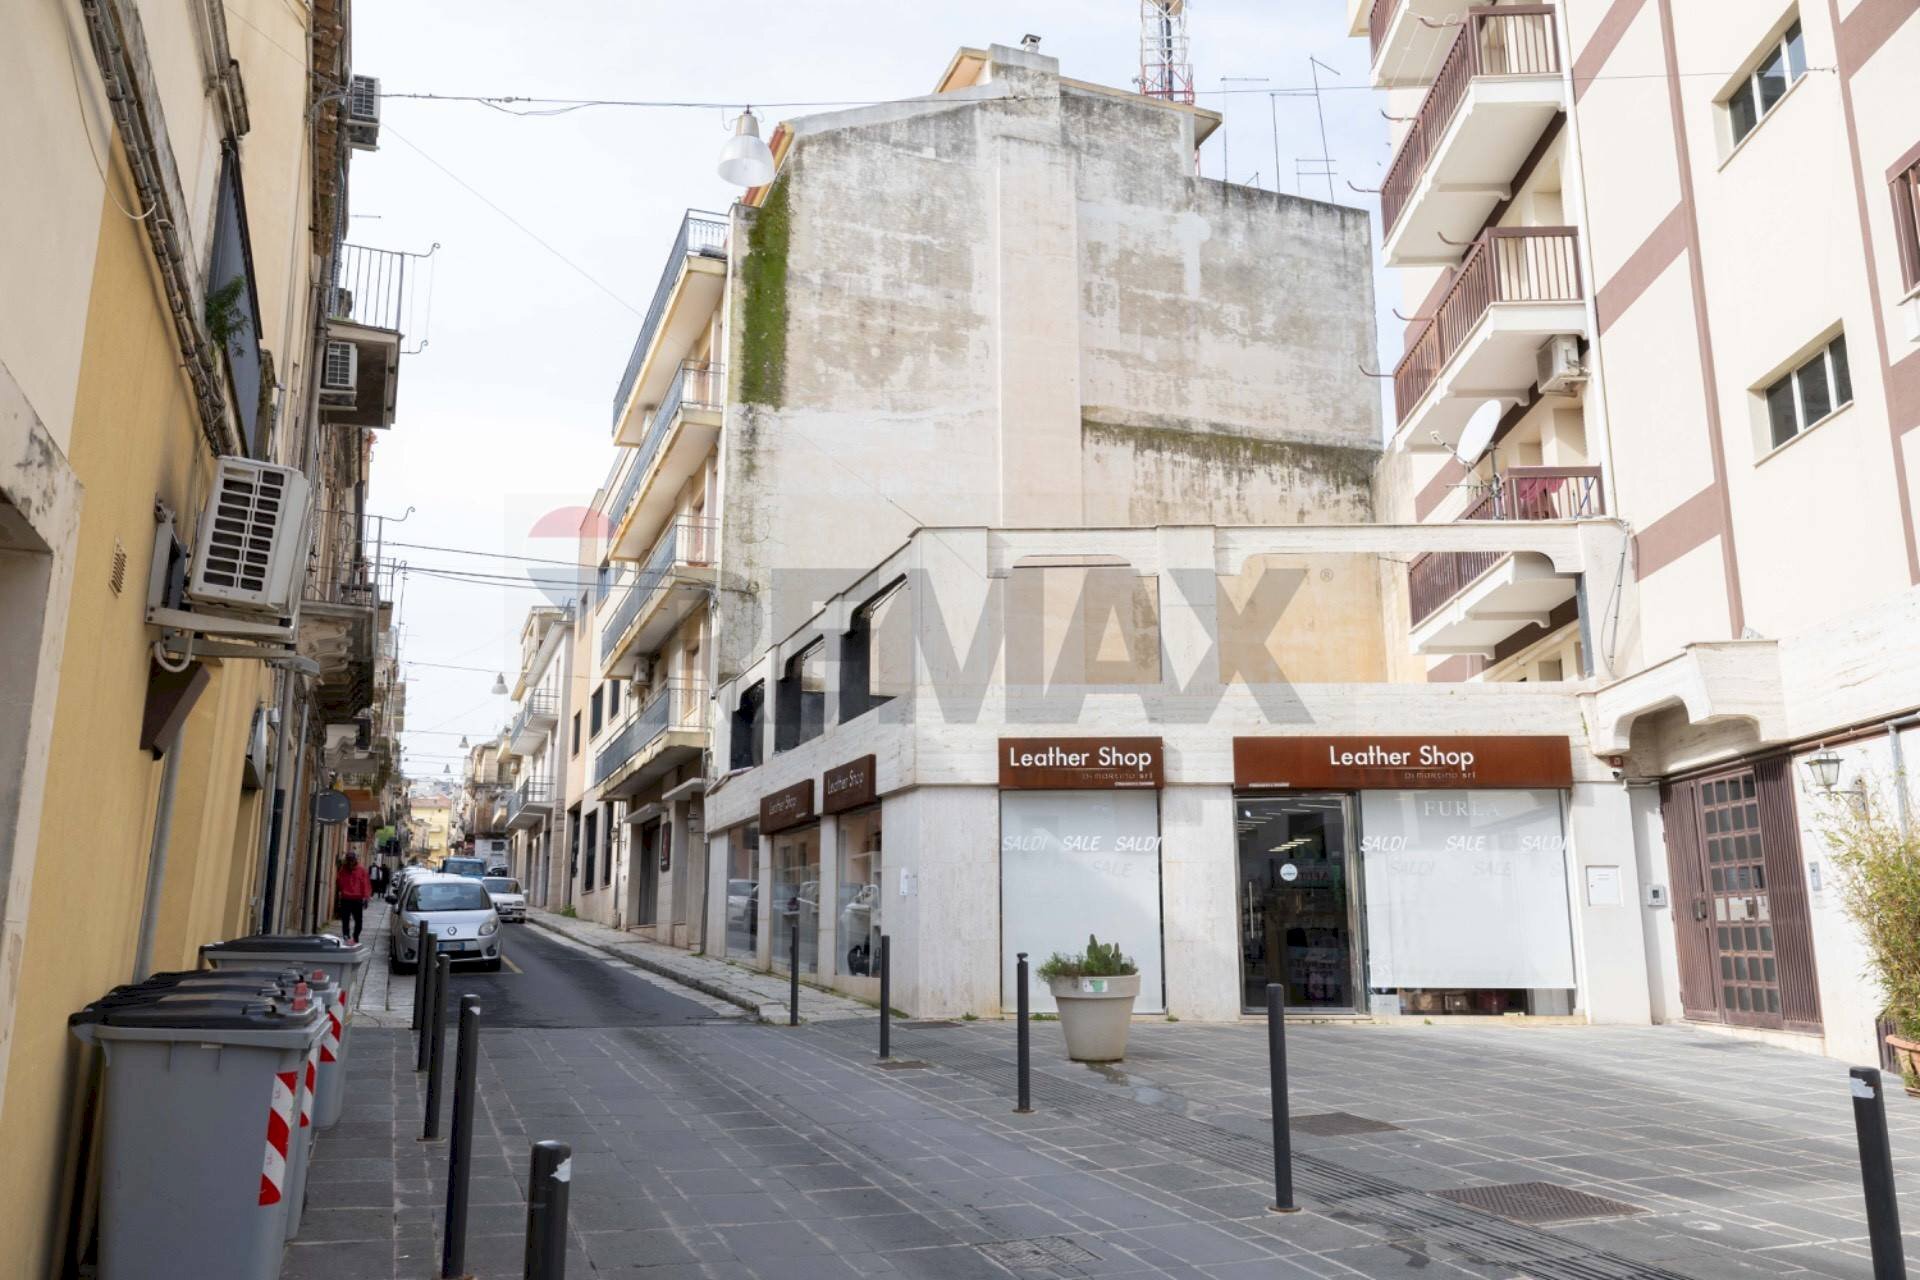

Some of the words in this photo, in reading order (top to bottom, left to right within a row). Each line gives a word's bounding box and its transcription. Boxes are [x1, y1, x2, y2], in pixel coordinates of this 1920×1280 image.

[1010, 746, 1090, 766] Leather
[1098, 746, 1152, 771] Shop
[1329, 745, 1411, 765] Leather
[1419, 745, 1474, 771] Shop
[1424, 800, 1502, 817] FURLA
[1002, 835, 1049, 851] SALDI
[1063, 835, 1102, 851] SALE
[1114, 835, 1162, 852] SALDI
[1360, 835, 1409, 852] SALDI
[1445, 835, 1486, 851] SALE
